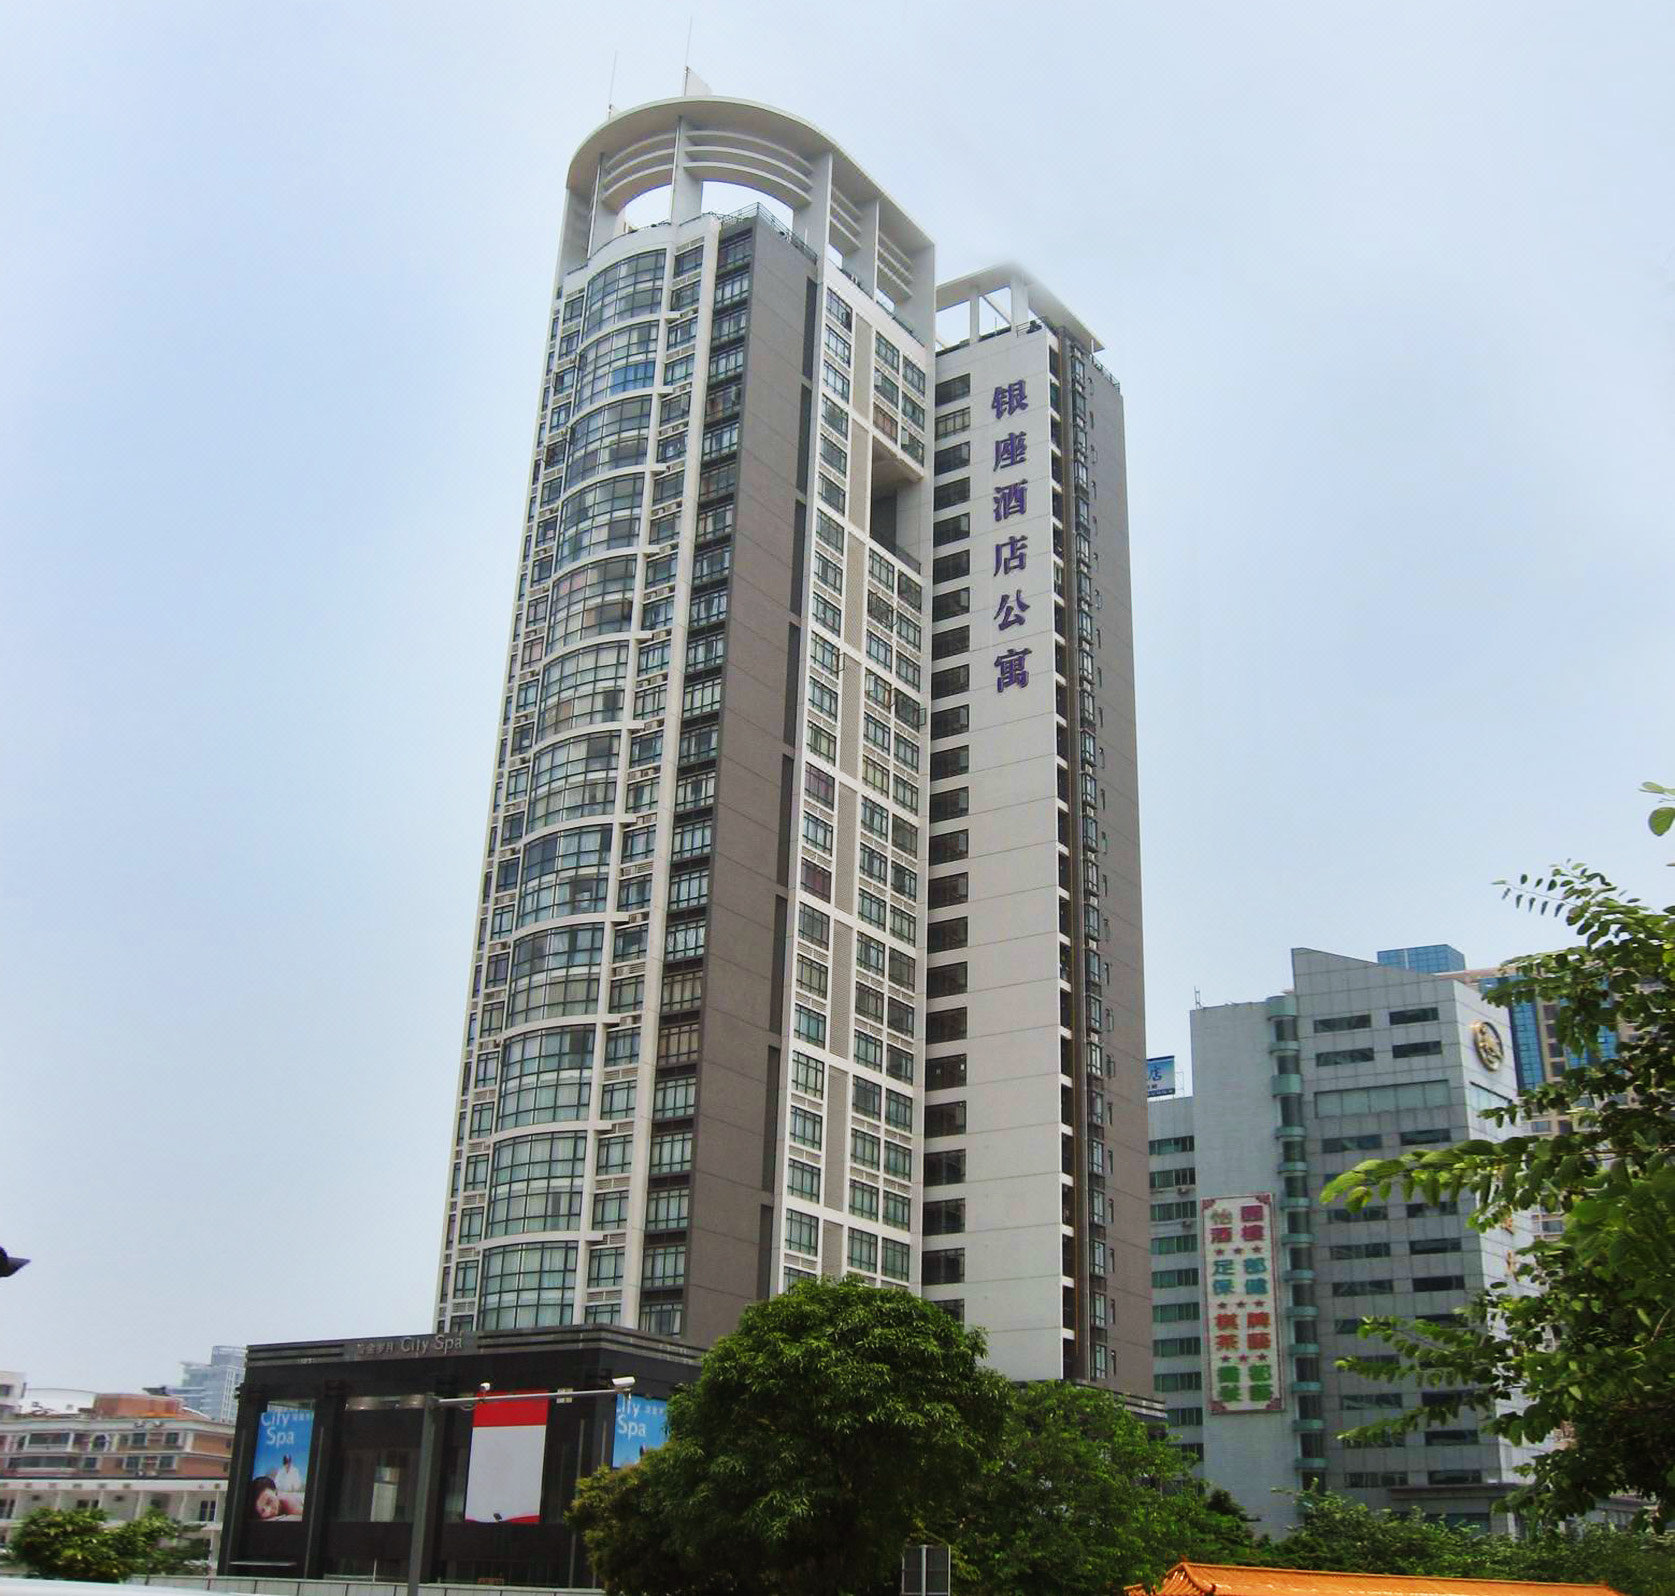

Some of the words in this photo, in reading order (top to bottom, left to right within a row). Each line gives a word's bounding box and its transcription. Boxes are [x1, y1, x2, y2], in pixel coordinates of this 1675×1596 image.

[991, 378, 1032, 694] 银座酒店公寓
[401, 1336, 430, 1354] City
[434, 1333, 463, 1354] Spa
[266, 1426, 295, 1448] Spa
[617, 1414, 646, 1441] Spa
